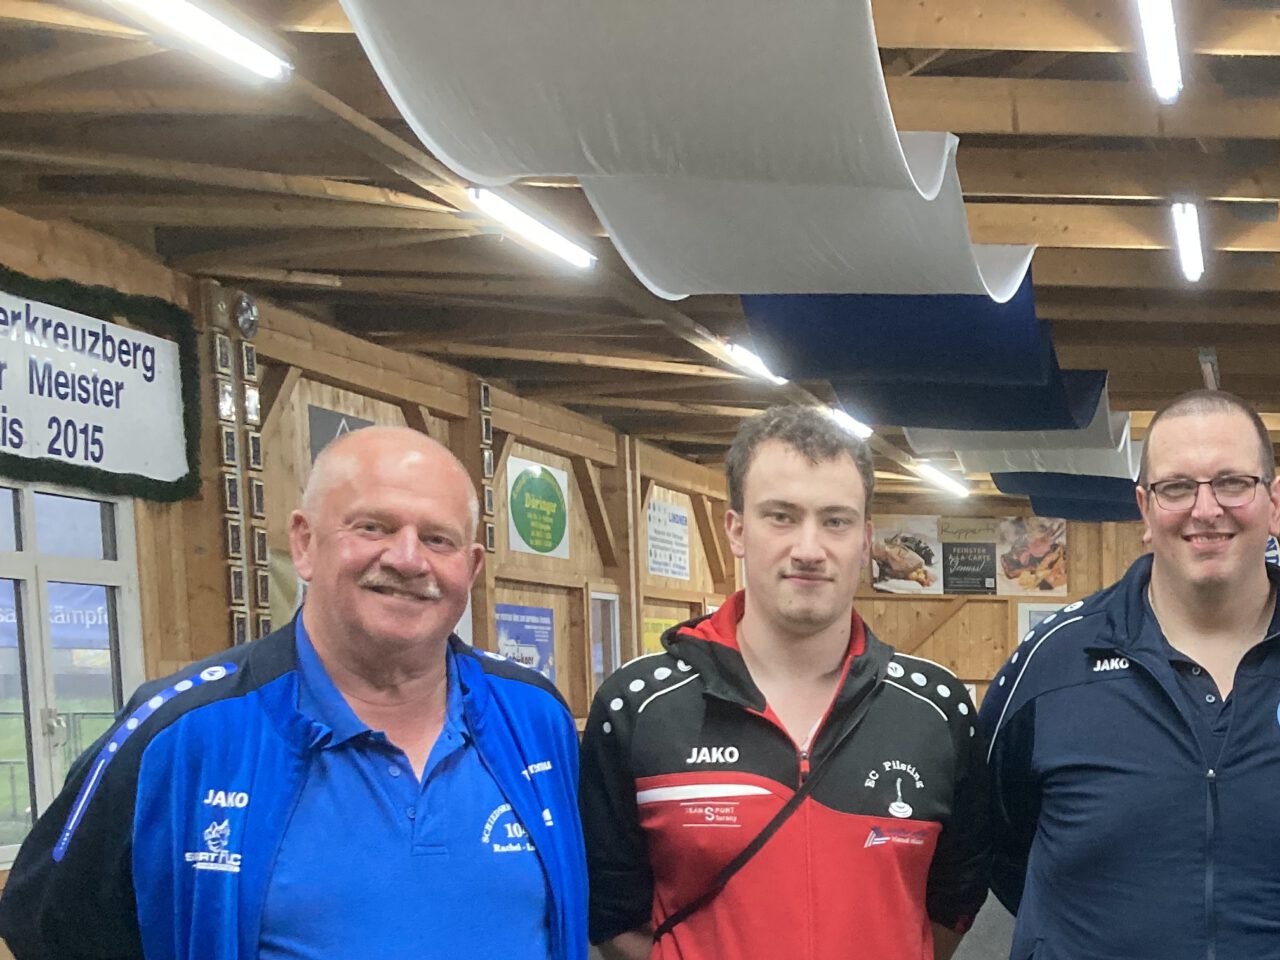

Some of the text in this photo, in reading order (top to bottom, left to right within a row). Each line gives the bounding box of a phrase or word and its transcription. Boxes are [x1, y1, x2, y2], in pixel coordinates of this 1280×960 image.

[28, 354, 124, 409] Meister
[0, 405, 104, 463] is 2015
[1092, 657, 1130, 672] JAKO
[686, 746, 740, 764] JAKO
[864, 760, 925, 789] EC Pilsting
[203, 789, 249, 808] JAKO
